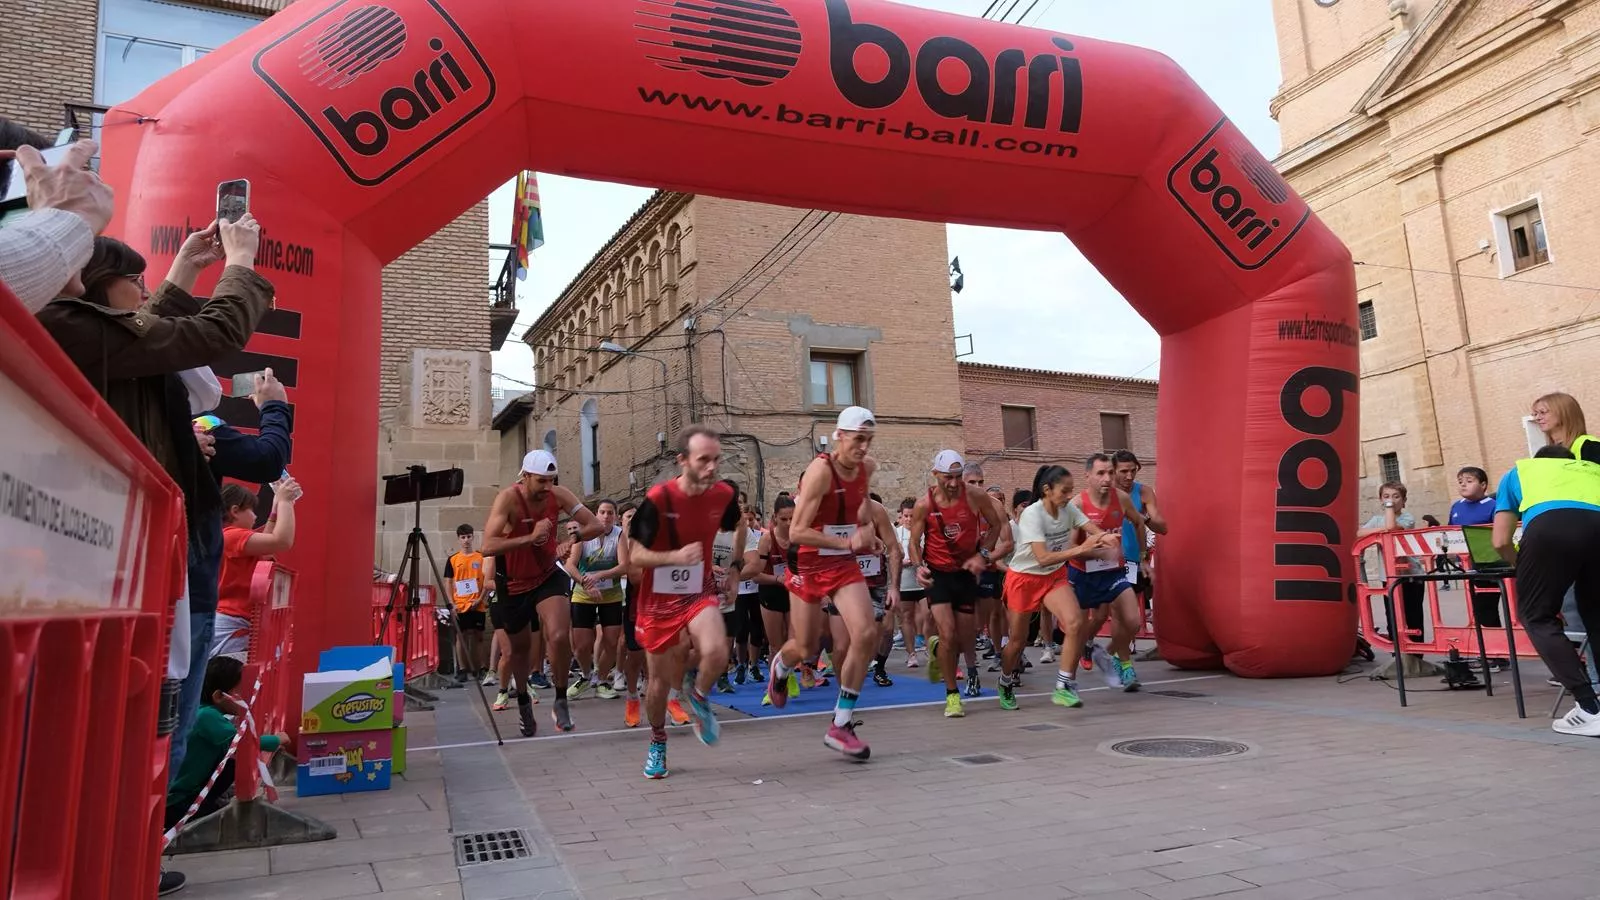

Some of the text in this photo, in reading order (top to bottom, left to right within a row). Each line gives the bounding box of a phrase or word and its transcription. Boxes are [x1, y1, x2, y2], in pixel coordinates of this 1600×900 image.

[322, 37, 473, 157] barri
[637, 86, 1079, 158] www.barri-ball.com
[823, 0, 1083, 134] barri
[1190, 148, 1280, 251] barri
[1274, 366, 1359, 602] barri
[671, 569, 690, 582] 60
